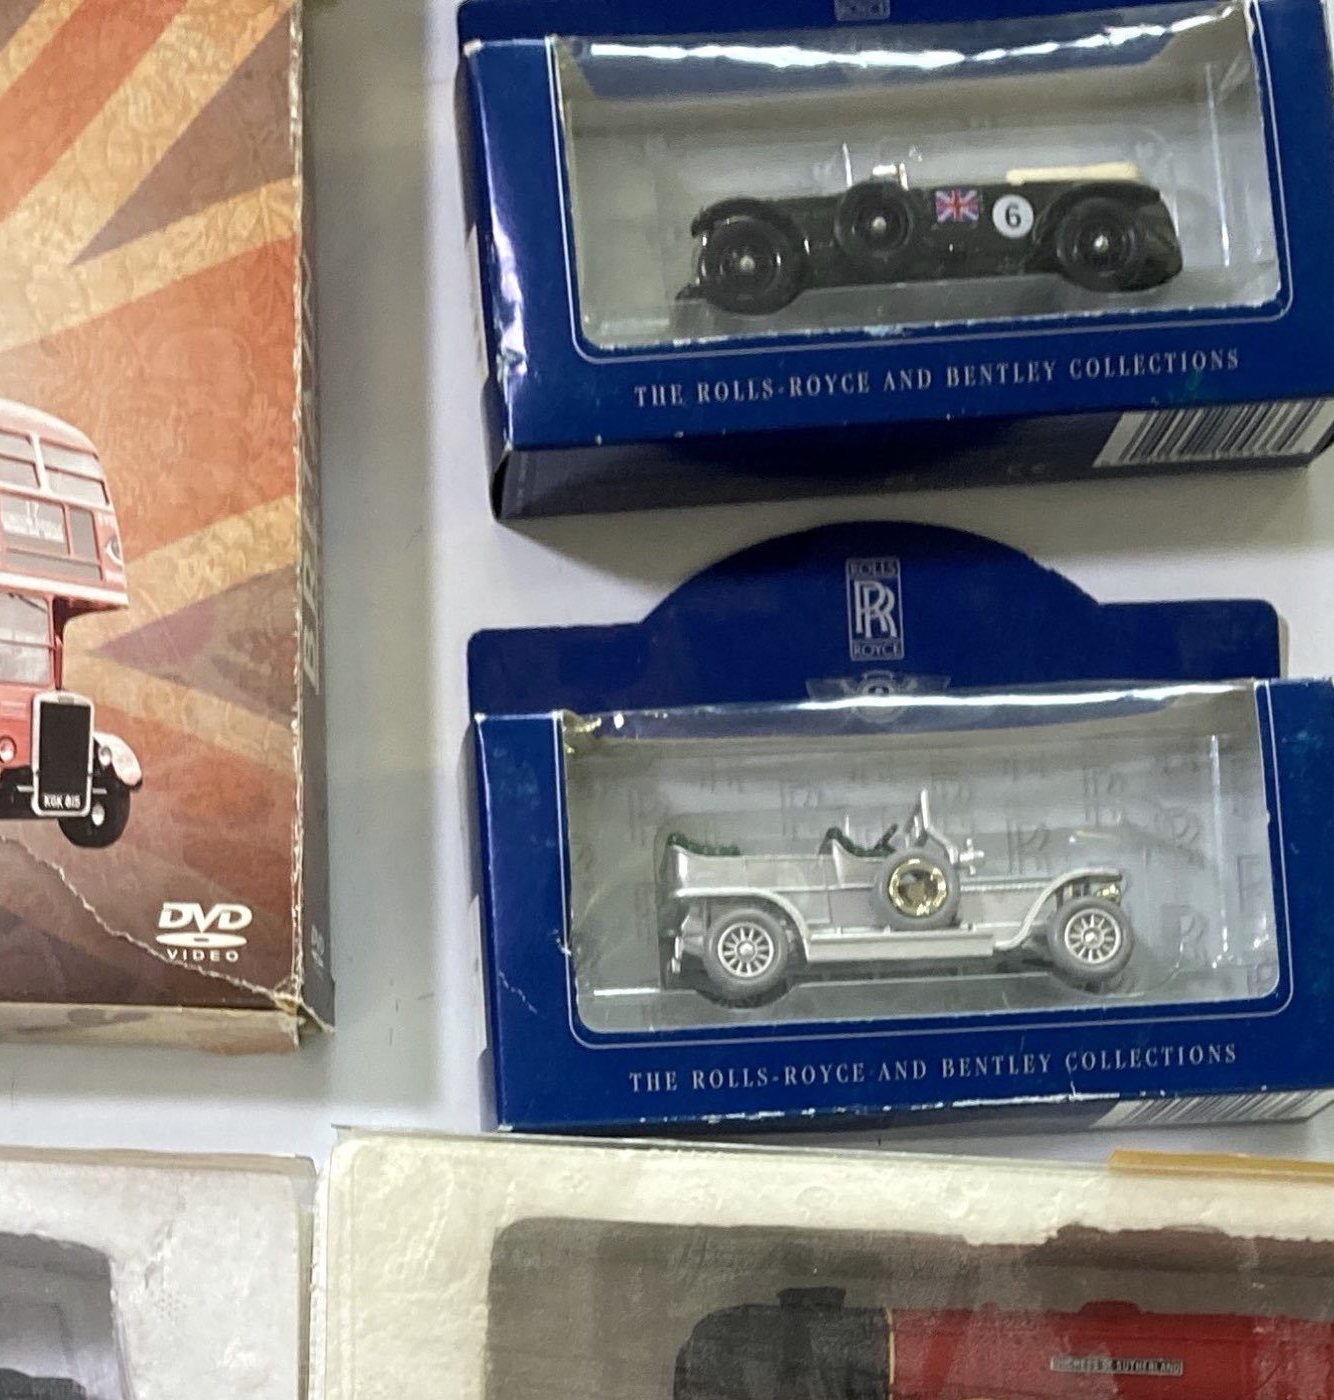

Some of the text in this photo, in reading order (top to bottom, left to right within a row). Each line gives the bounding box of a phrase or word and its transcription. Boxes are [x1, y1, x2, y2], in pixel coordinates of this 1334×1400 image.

[1004, 202, 1022, 230] 6
[634, 348, 1239, 407] THE ROLLS-ROYCE AND BENTLEY COLLECTIONS
[158, 902, 253, 932] DVD
[167, 949, 240, 963] VIDEO
[629, 1043, 1237, 1092] THE ROLLS-ROYCE AND BENTLEY COLLECTIONS
